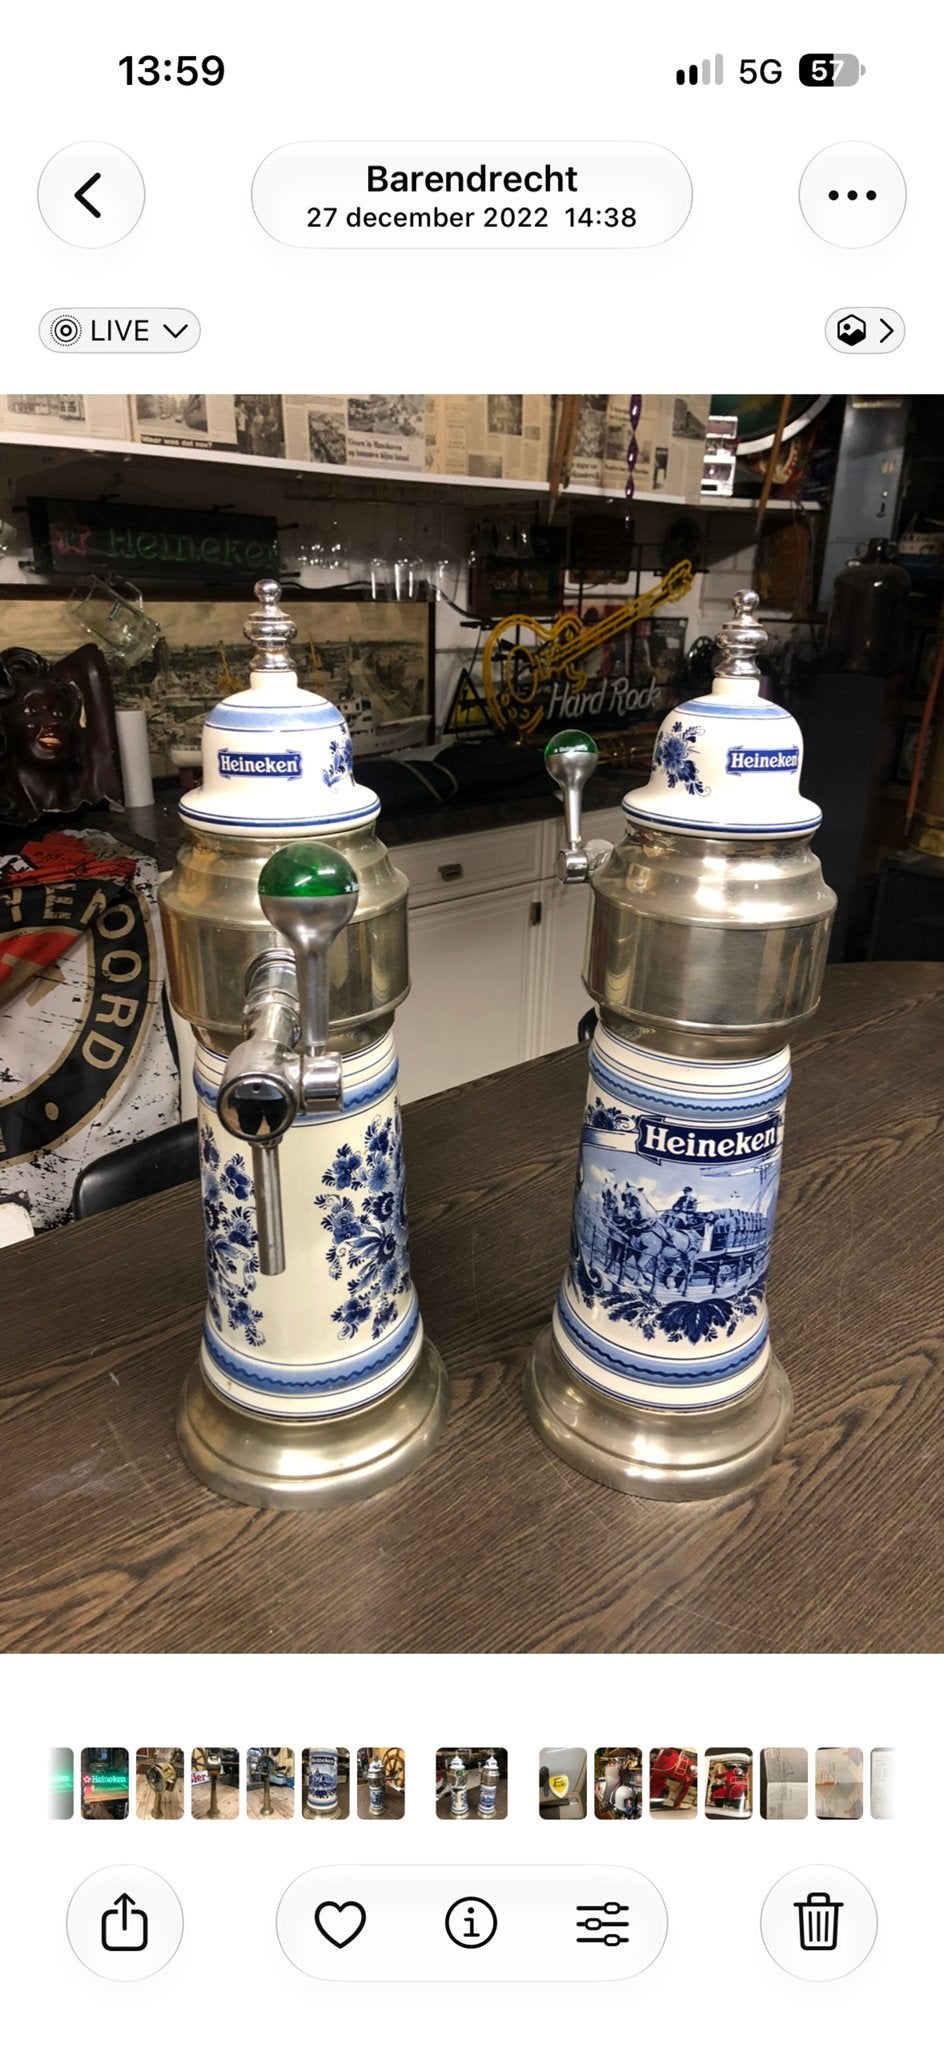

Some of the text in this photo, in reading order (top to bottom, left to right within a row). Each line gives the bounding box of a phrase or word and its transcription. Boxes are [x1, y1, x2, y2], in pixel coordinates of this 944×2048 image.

[547, 676, 662, 719] Hard Rock
[220, 755, 299, 773] Heineken
[730, 752, 798, 769] Heineken
[644, 1124, 776, 1158] Heineken
